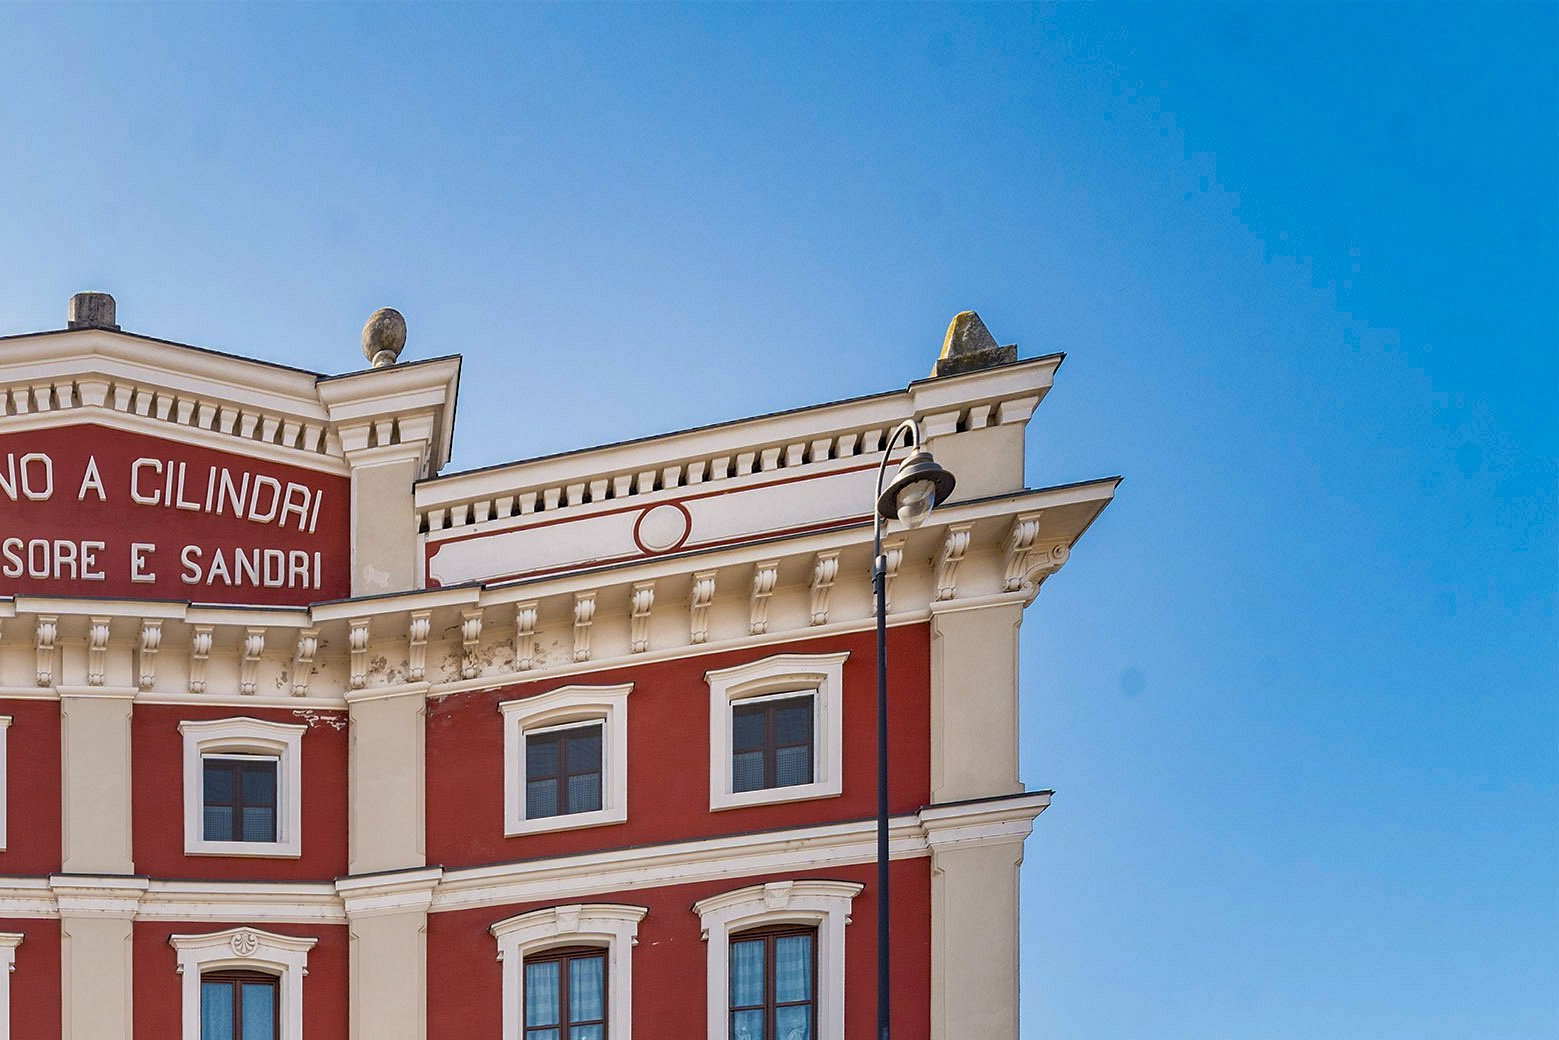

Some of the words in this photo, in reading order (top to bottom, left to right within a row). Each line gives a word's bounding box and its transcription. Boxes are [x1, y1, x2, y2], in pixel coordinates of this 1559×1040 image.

[78, 455, 107, 502] A
[130, 457, 324, 535] CILINDRI
[131, 543, 157, 584] E
[181, 545, 322, 591] SANDRI
